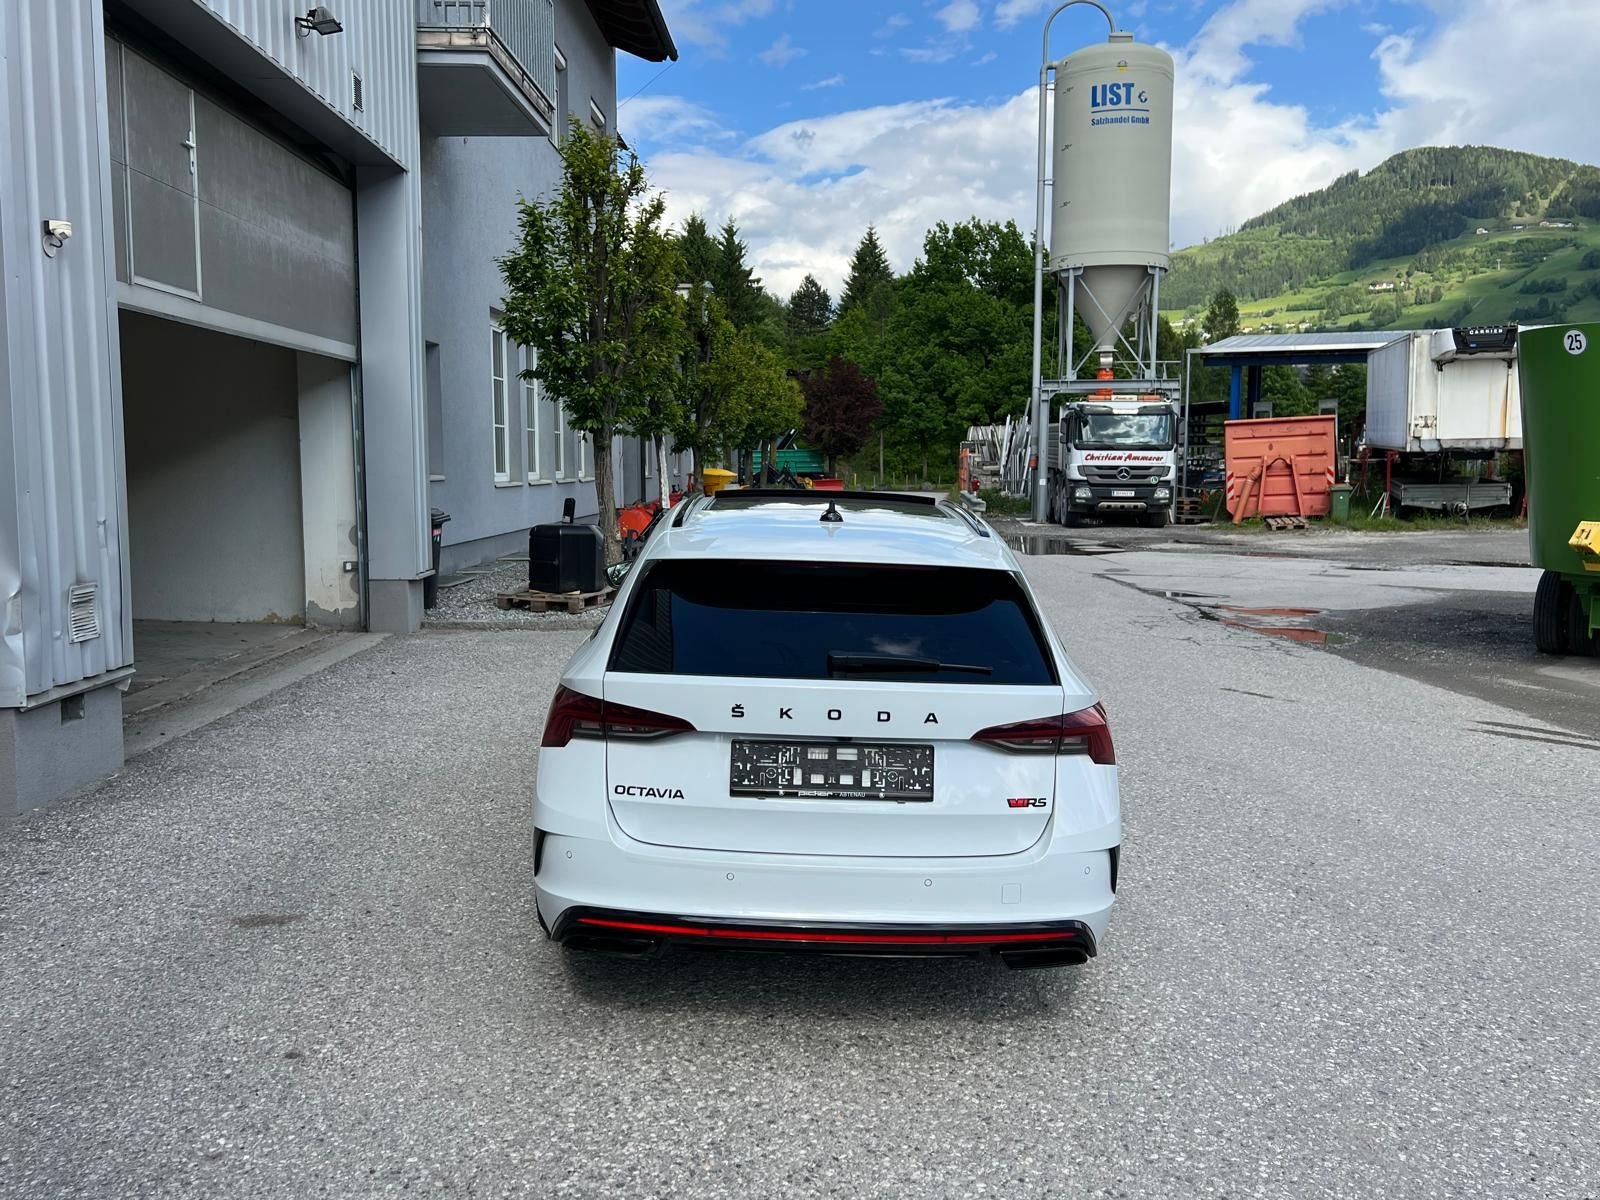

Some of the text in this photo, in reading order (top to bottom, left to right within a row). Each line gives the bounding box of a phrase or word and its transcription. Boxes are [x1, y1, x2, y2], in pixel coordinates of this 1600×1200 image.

[1091, 82, 1135, 108] LIST
[1091, 115, 1130, 126] Salzhandel
[1567, 333, 1583, 351] 25
[1084, 453, 1124, 462] Christian
[731, 703, 939, 724] ŠKODA
[614, 784, 685, 800] OCTAVIA
